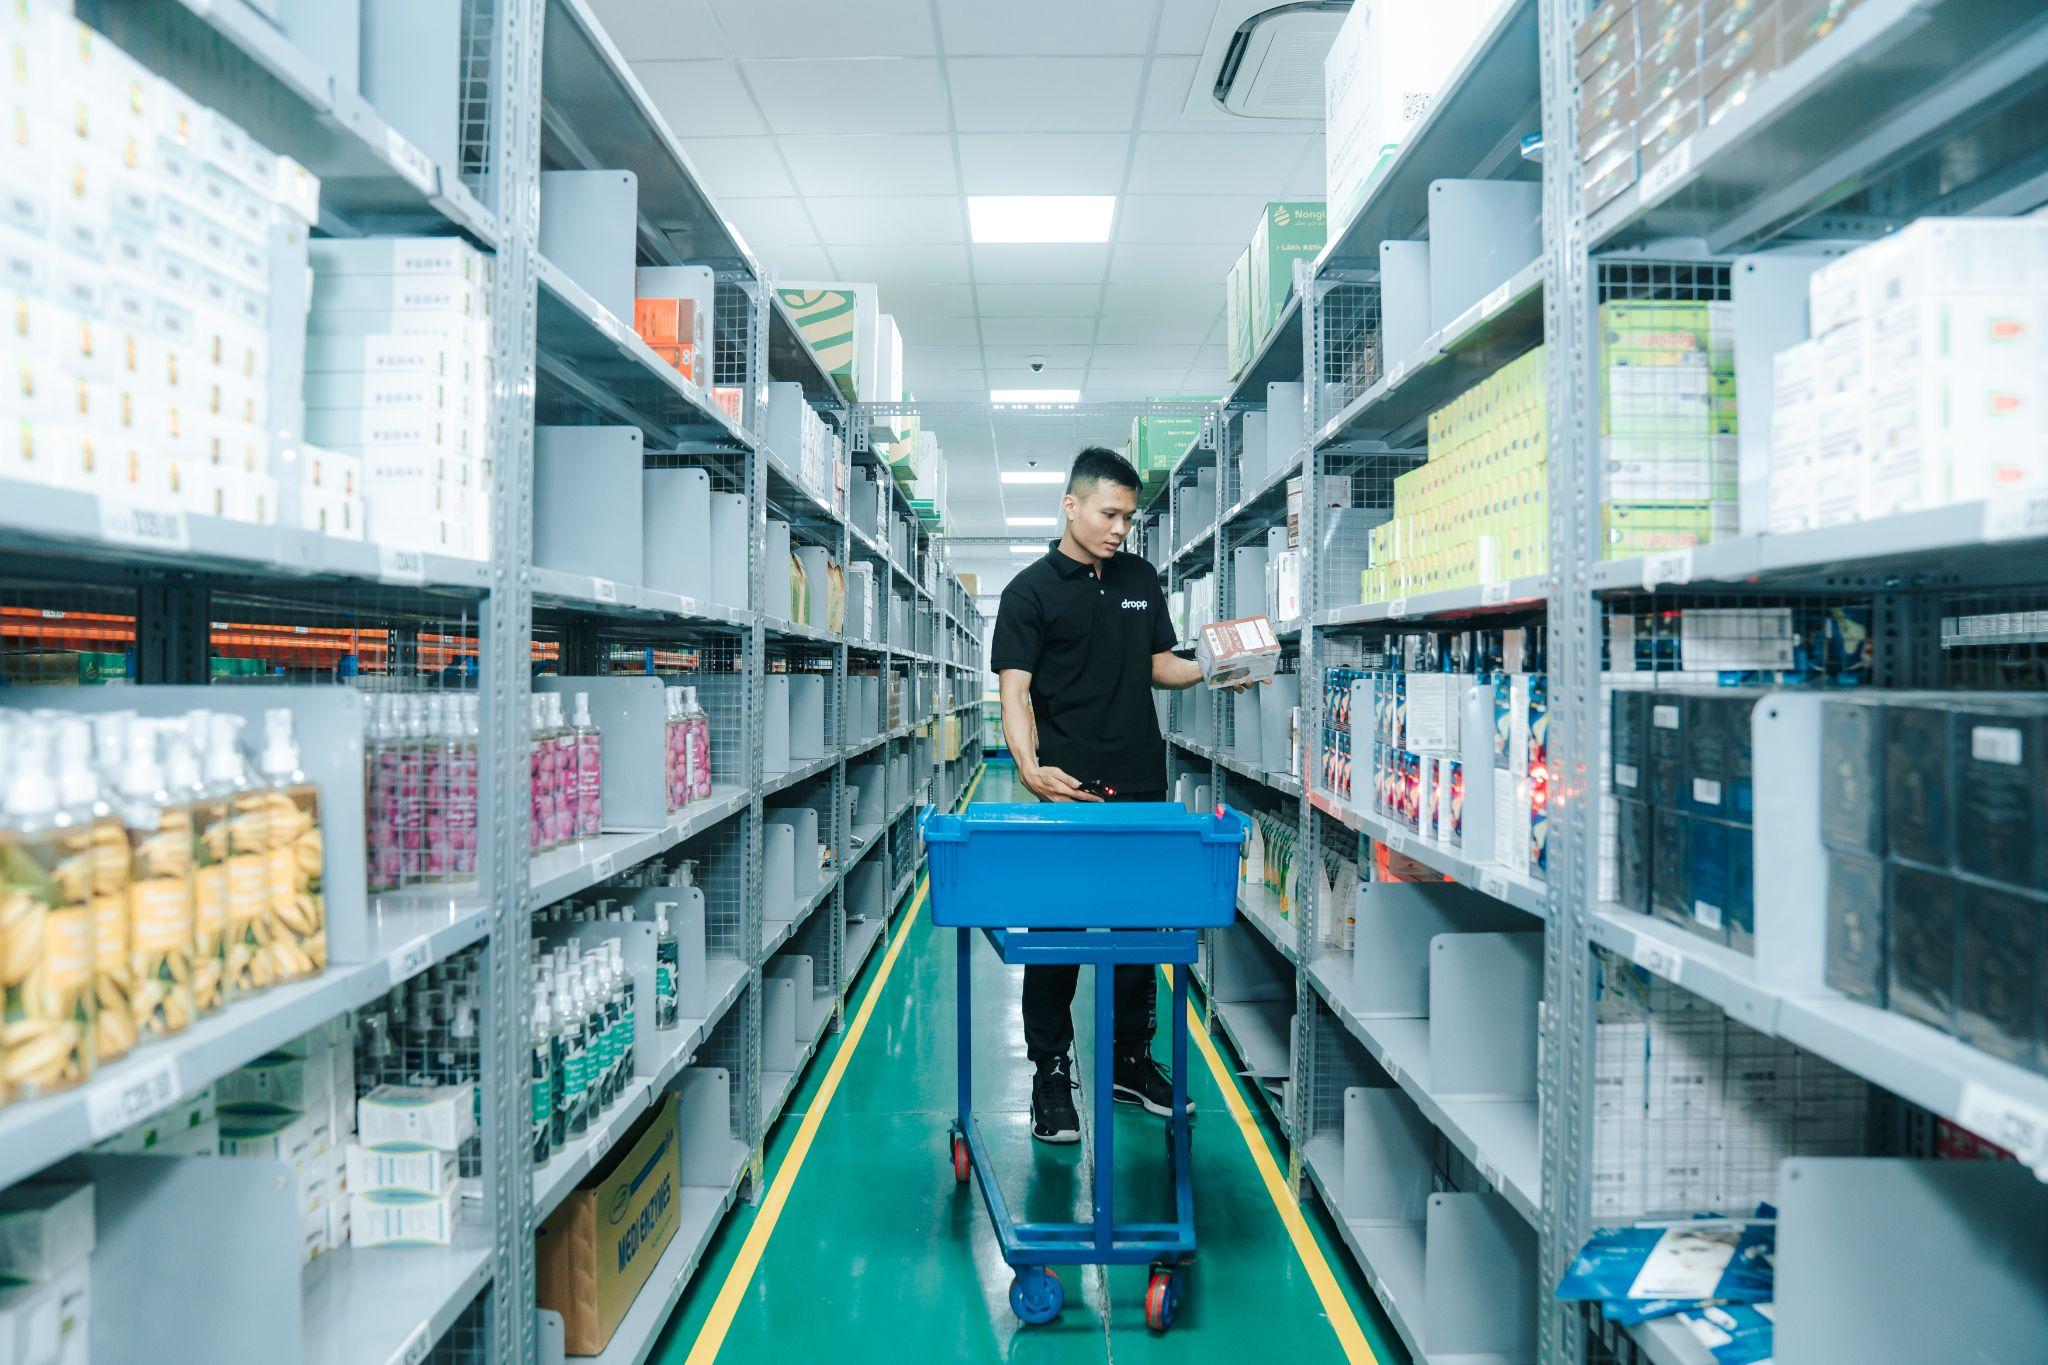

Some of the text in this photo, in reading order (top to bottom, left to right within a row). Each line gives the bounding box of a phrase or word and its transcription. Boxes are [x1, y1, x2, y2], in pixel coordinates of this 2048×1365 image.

[1295, 210, 1327, 220] Nongl
[1121, 598, 1148, 610] dropp
[618, 1219, 639, 1274] MEDI
[640, 1172, 671, 1242] ENZYMES
